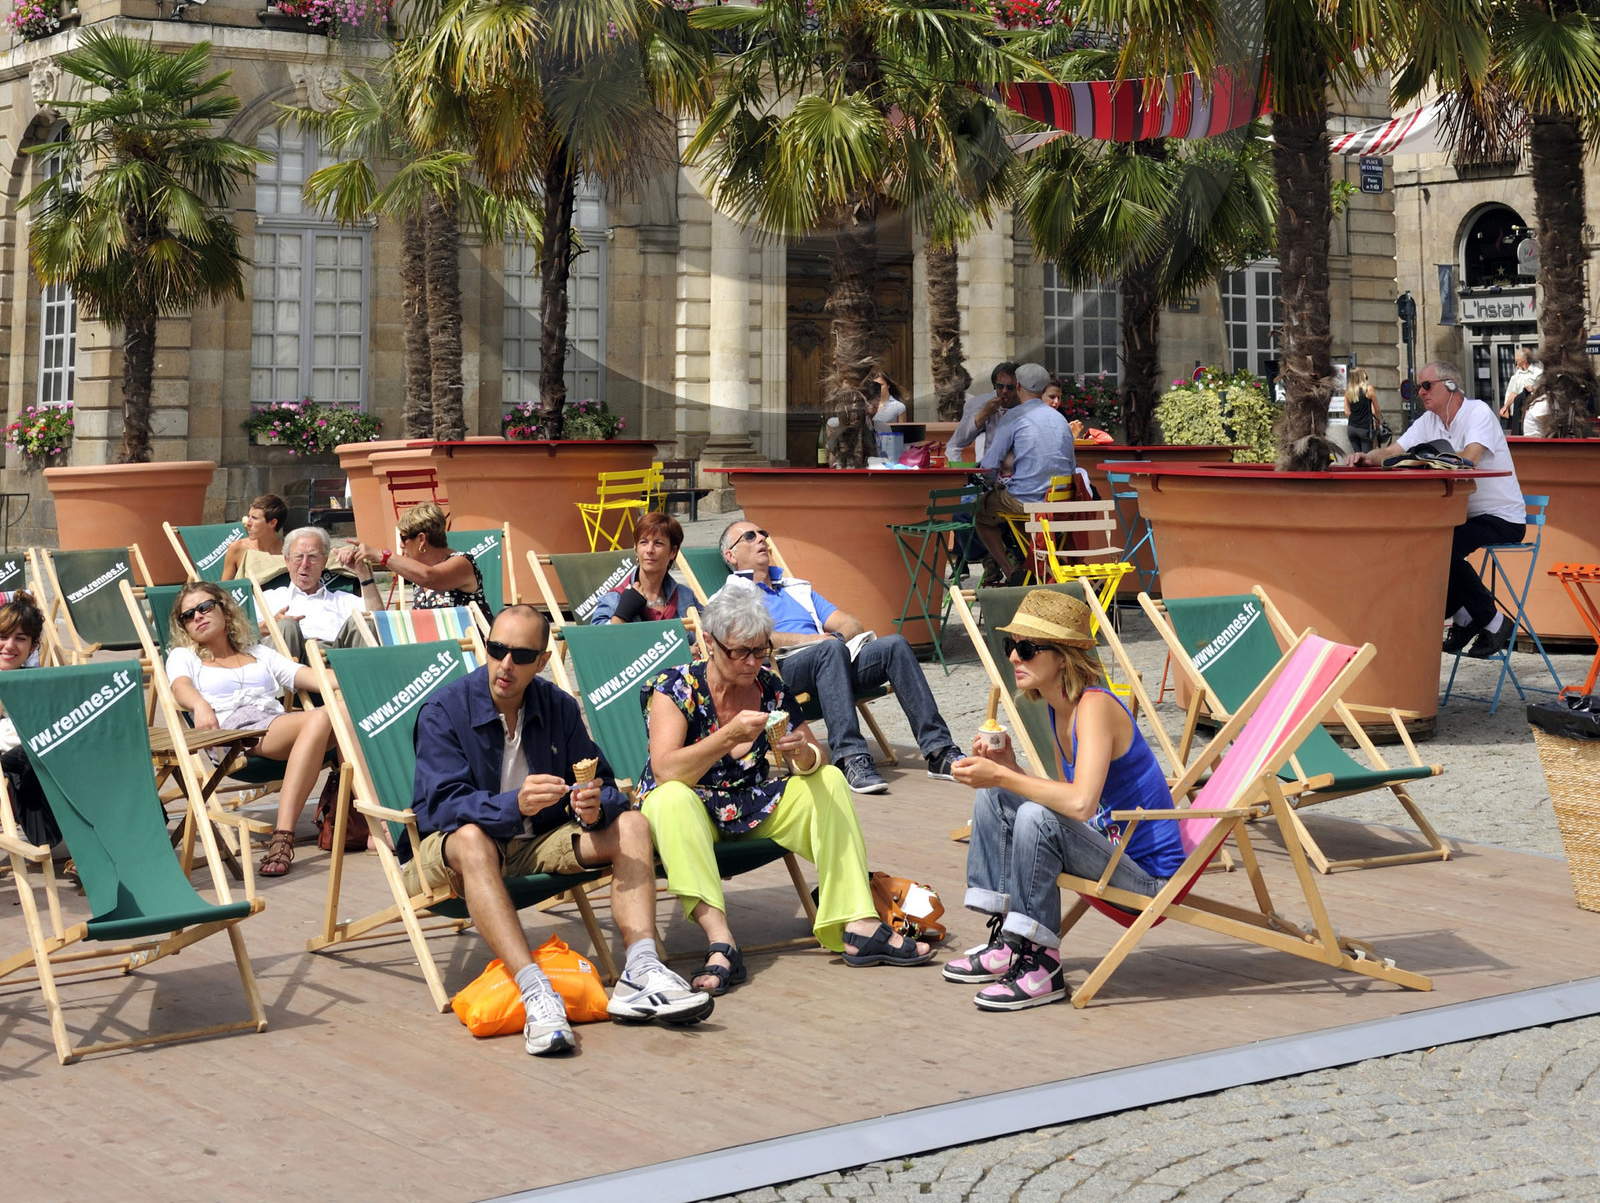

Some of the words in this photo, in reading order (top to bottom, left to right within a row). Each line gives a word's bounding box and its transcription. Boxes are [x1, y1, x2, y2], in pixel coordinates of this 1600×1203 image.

[196, 527, 242, 568] www.rennes.fr
[67, 561, 126, 601] www.rennes.fr
[575, 557, 634, 617] www.rennes.fr
[1192, 601, 1257, 668] www.rennes.fr
[358, 649, 454, 732] www.rennes.fr
[588, 628, 678, 705] www.rennes.fr
